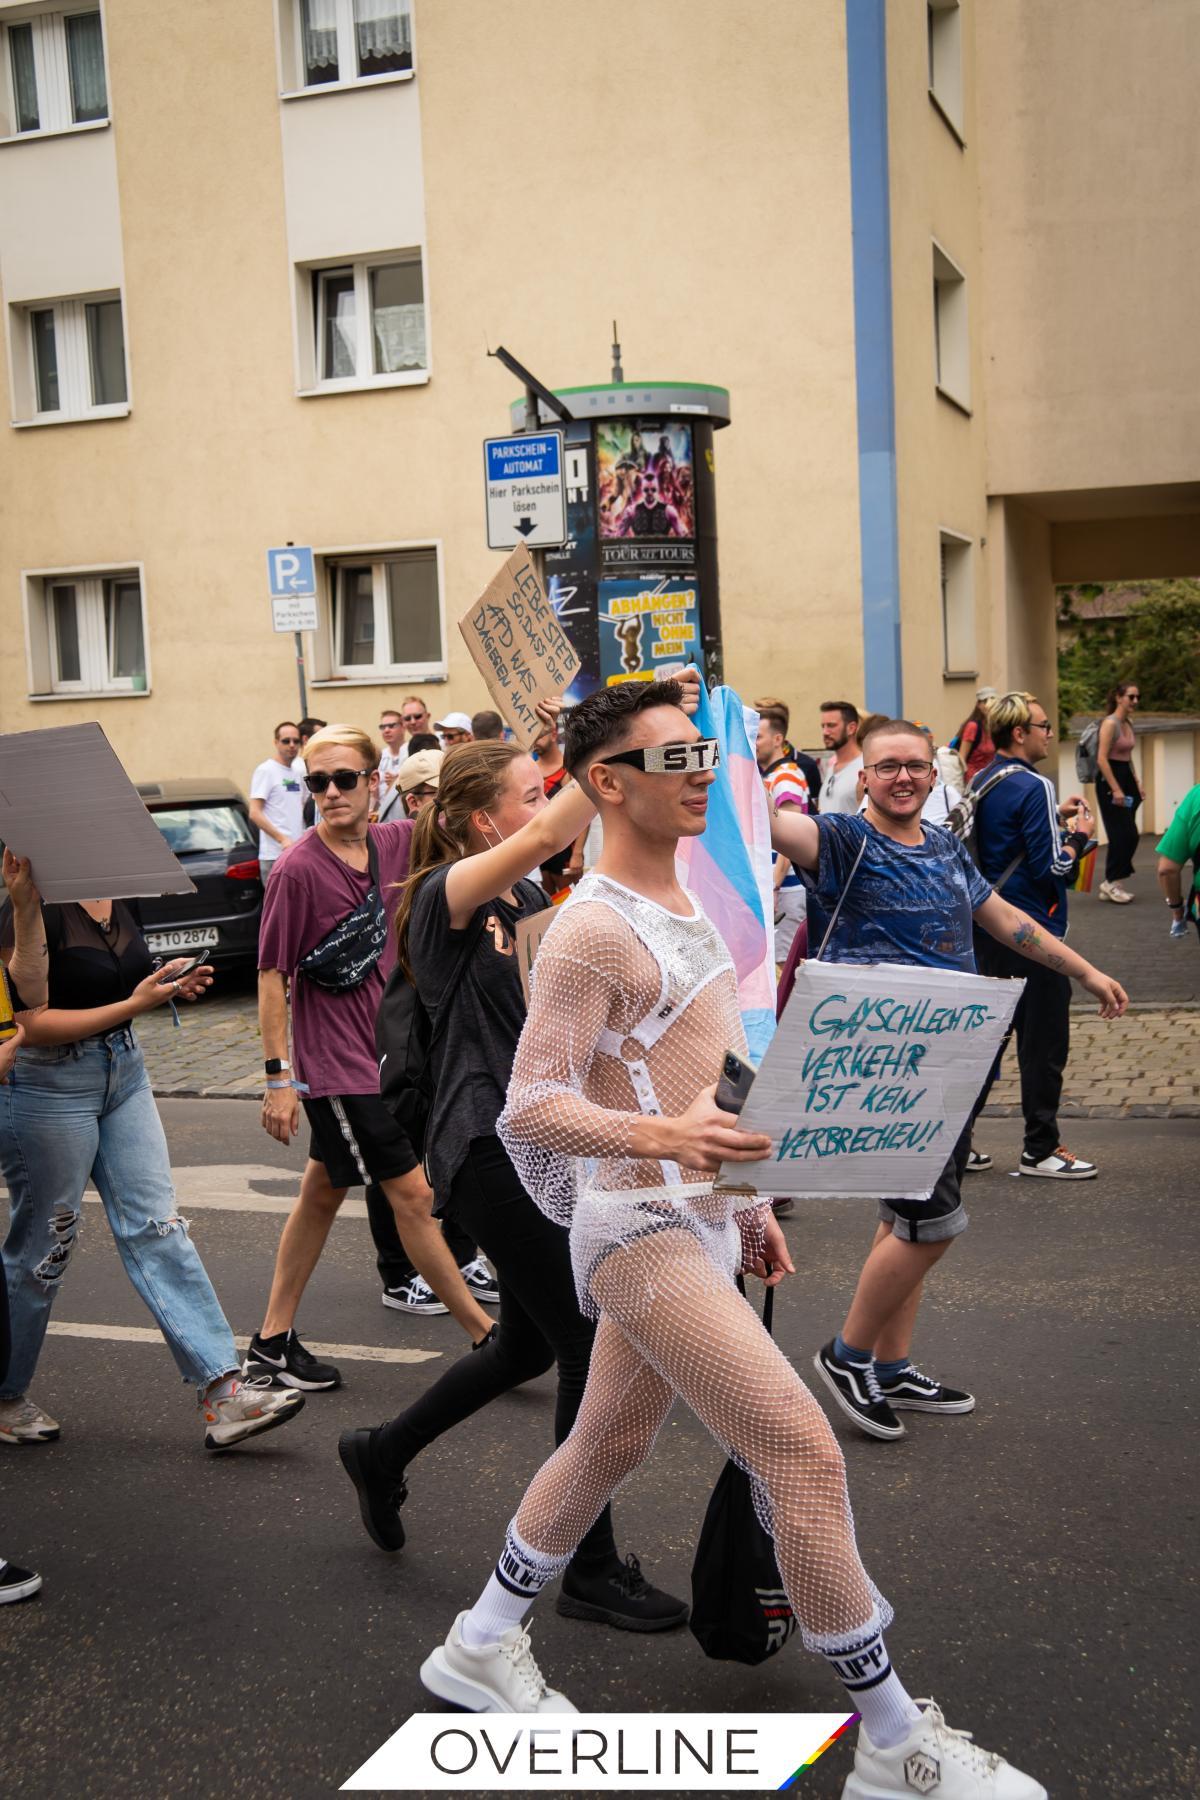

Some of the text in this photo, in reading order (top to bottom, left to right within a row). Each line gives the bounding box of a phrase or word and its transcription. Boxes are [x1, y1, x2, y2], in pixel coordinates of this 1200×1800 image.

[492, 442, 553, 460] PARKSCHEIN-
[503, 458, 544, 475] AUTOMAT
[489, 481, 560, 499] Hier Parkschein
[512, 500, 537, 513] lösen
[602, 548, 635, 561] TOUR
[659, 546, 695, 560] TOURS
[513, 564, 549, 624] LEBE
[610, 590, 695, 616] ABHÄNGEN?
[652, 611, 685, 627] NICHT
[660, 624, 695, 640] OHNE
[654, 643, 684, 657] MEIN
[472, 605, 540, 734] DAGEGEN HAT!
[510, 648, 538, 694] WAS
[545, 655, 565, 687] DIE
[183, 928, 216, 944] 2874
[801, 1041, 929, 1083] VERKEHR
[805, 1082, 928, 1115] IST KEIN
[776, 1119, 944, 1163] VERBRECHEN!
